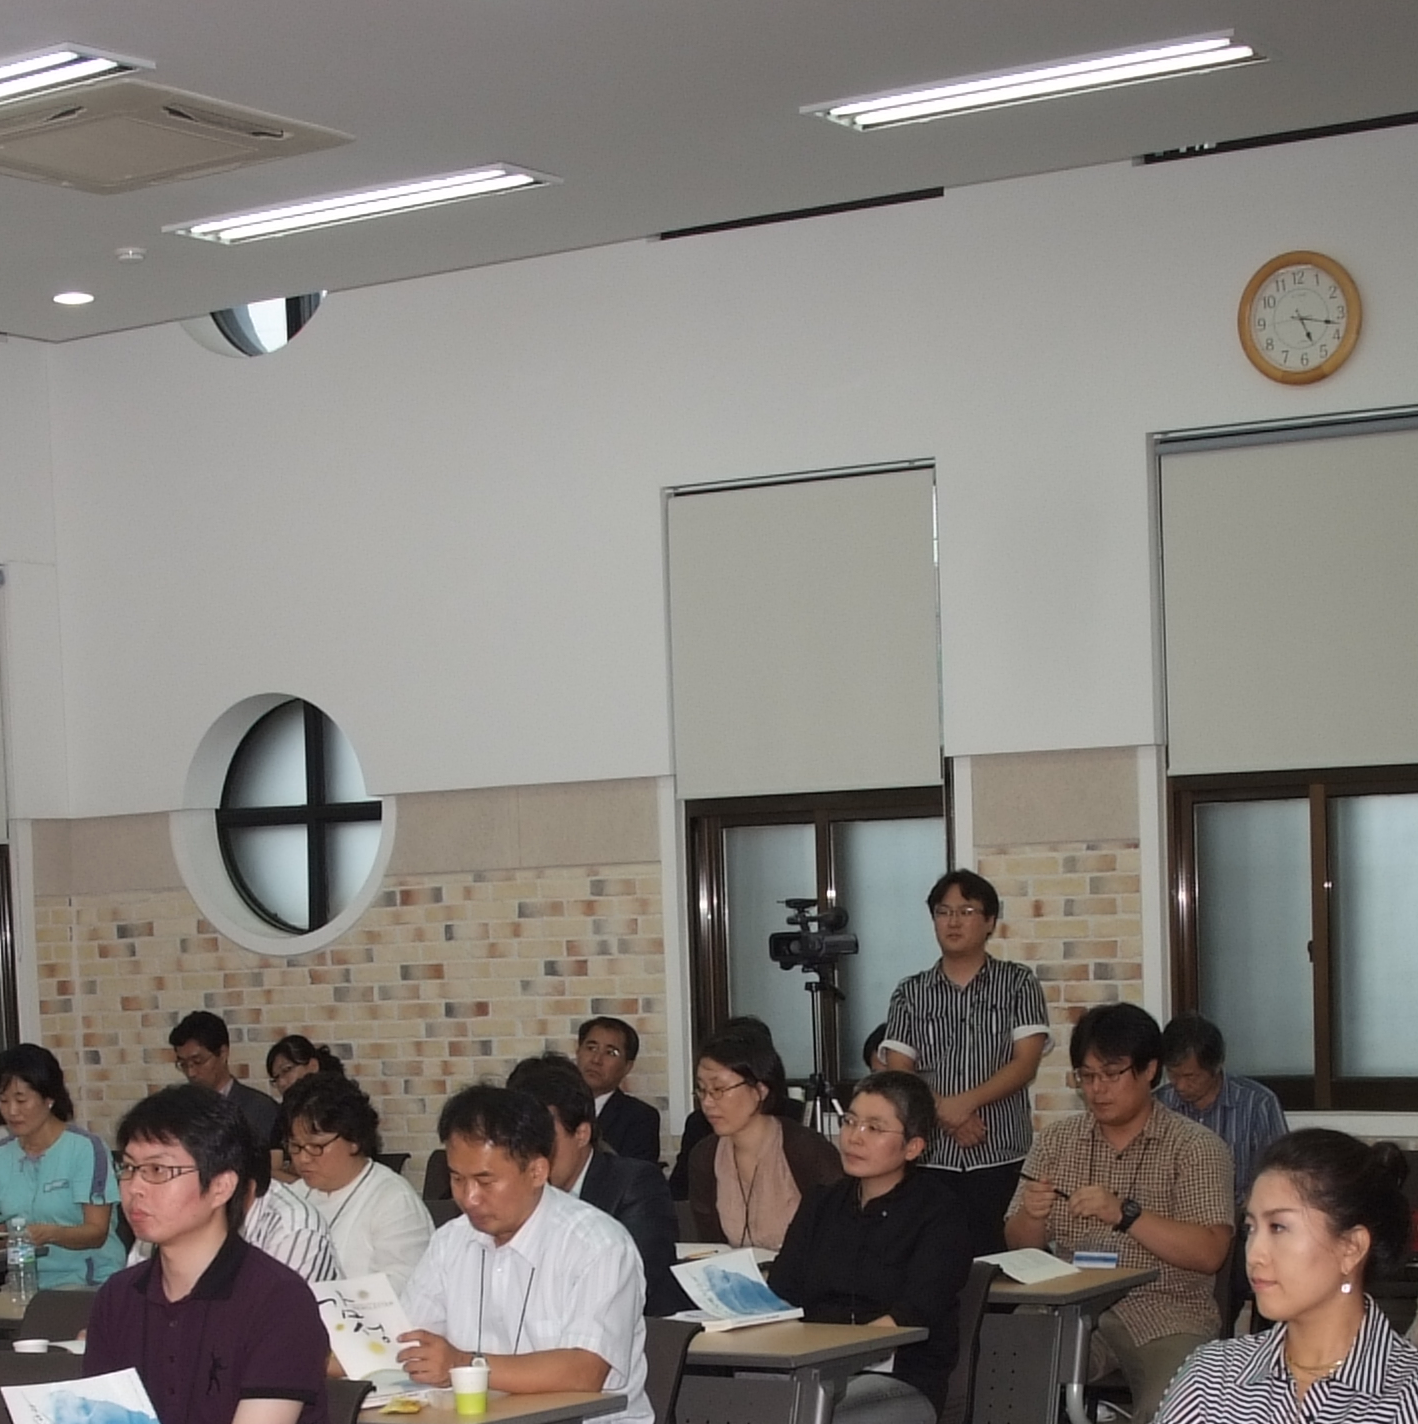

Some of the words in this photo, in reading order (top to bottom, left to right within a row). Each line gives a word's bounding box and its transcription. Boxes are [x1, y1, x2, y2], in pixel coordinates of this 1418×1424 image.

[1292, 271, 1305, 285] 12
[1314, 274, 1320, 286] 1
[1275, 279, 1286, 292] 11
[1328, 285, 1338, 299] 2
[1262, 295, 1276, 309] 10
[1336, 305, 1345, 319] 3
[1257, 318, 1266, 331] 9
[1332, 328, 1341, 340] 4
[1266, 338, 1275, 351] 8
[1281, 350, 1290, 364] 7
[1319, 345, 1328, 358] 5
[1300, 353, 1309, 366] 6
